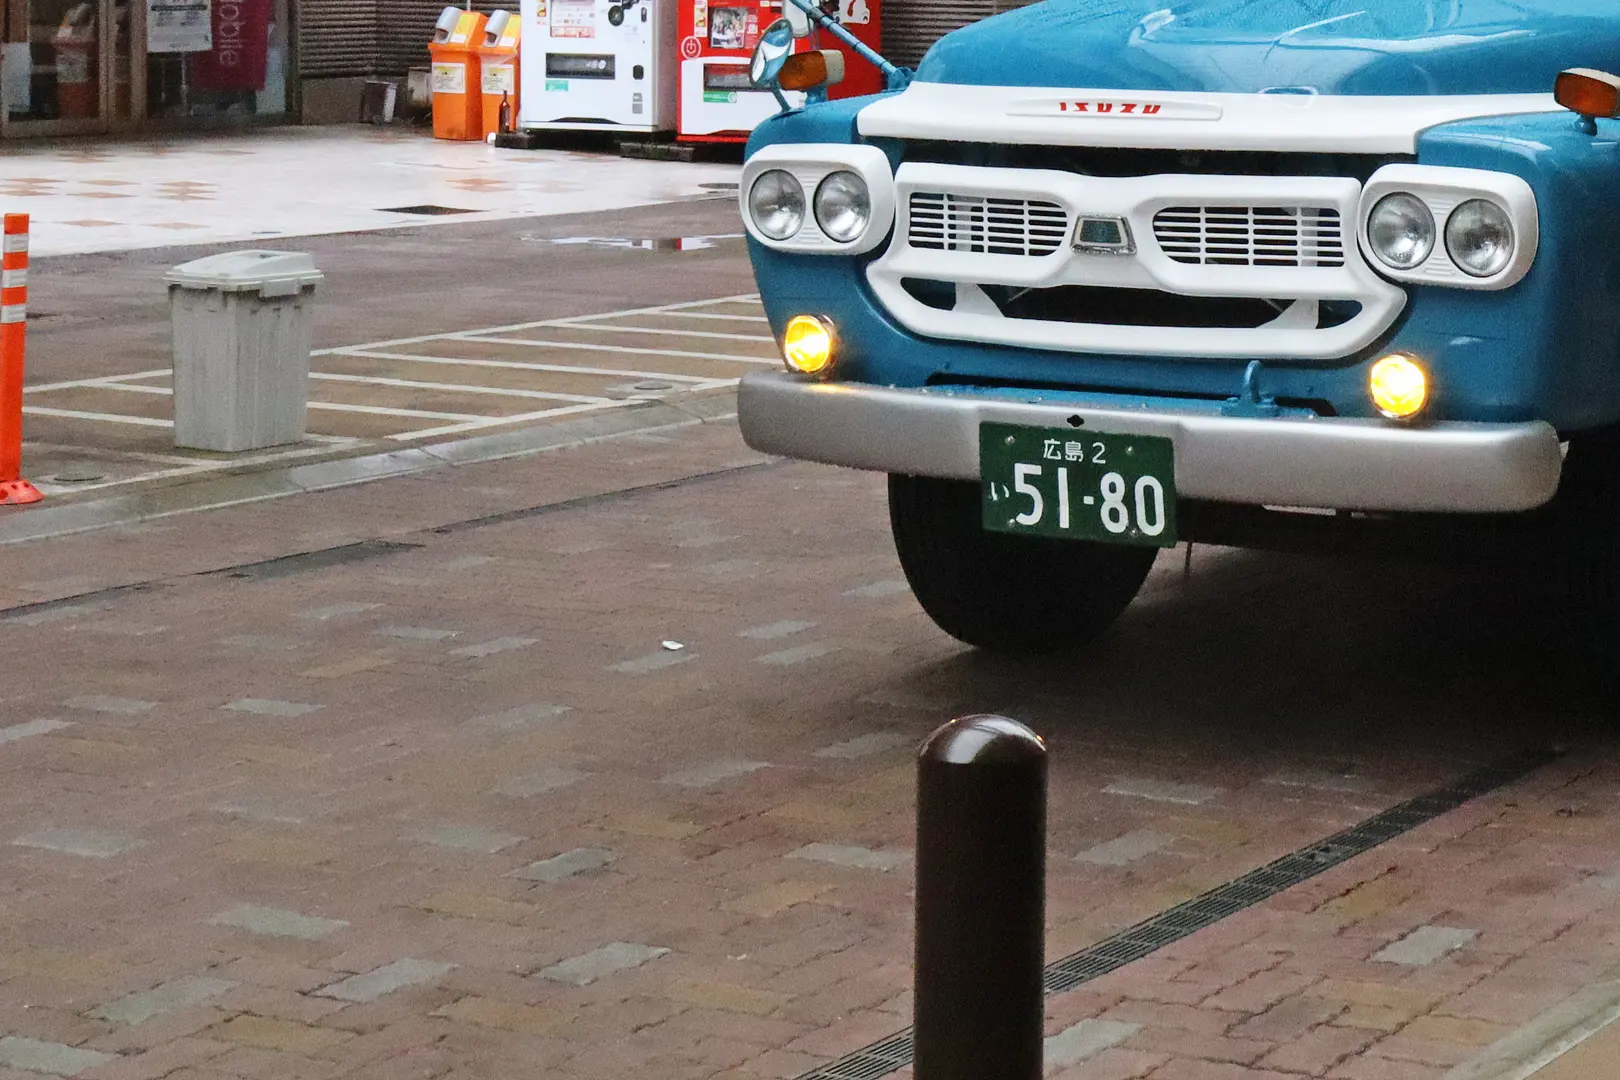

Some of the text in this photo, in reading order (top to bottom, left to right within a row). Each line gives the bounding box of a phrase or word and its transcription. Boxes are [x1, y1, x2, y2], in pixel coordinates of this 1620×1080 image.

[1059, 102, 1162, 115] ISUZU
[1043, 438, 1107, 464] 広島 2
[989, 462, 1167, 537] い 51-80
